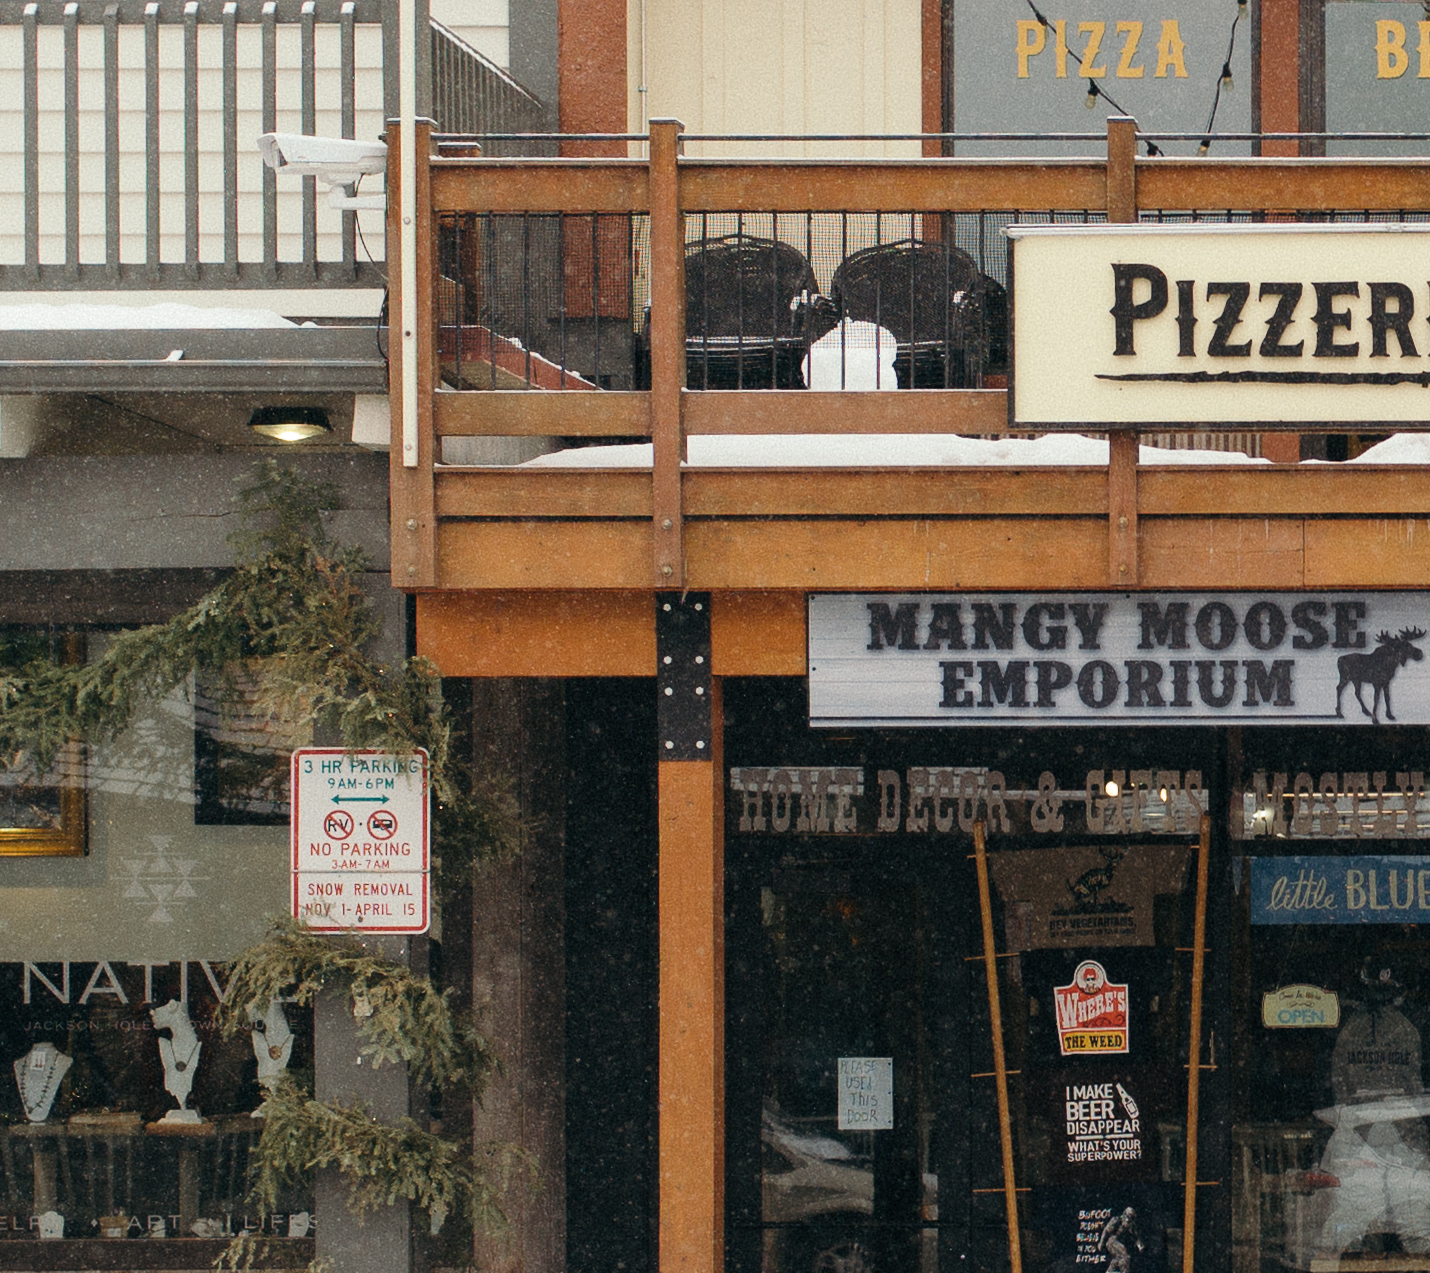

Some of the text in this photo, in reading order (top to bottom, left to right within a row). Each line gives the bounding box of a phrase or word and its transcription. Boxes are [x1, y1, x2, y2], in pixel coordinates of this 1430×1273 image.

[1015, 19, 1188, 79] PIZZA
[866, 601, 1367, 651] MANGY MOOSE
[938, 659, 1295, 709] EMPORIUM
[304, 760, 313, 774] 3
[321, 760, 342, 774] HR
[327, 778, 395, 790] 9AM-6PM
[739, 769, 1204, 833] HOME DECOR & GIFTS
[1253, 771, 1424, 835] MOSTLY
[327, 818, 349, 832] RV
[310, 842, 411, 856] NO PARKING
[308, 883, 413, 896] SNOW REMOVAL
[1266, 869, 1339, 911] little
[305, 903, 331, 916] NOV
[403, 903, 415, 916] 15
[1277, 1009, 1325, 1024] OPEN
[1065, 1034, 1123, 1049] THE WEED
[1066, 1083, 1114, 1100] I MAKE
[1066, 1101, 1115, 1121] BEER
[1066, 1119, 1140, 1136] DISAPPEAR
[1067, 1139, 1141, 1152] WHAT'S YOUR
[1067, 1149, 1142, 1162] SUPERPOWER?
